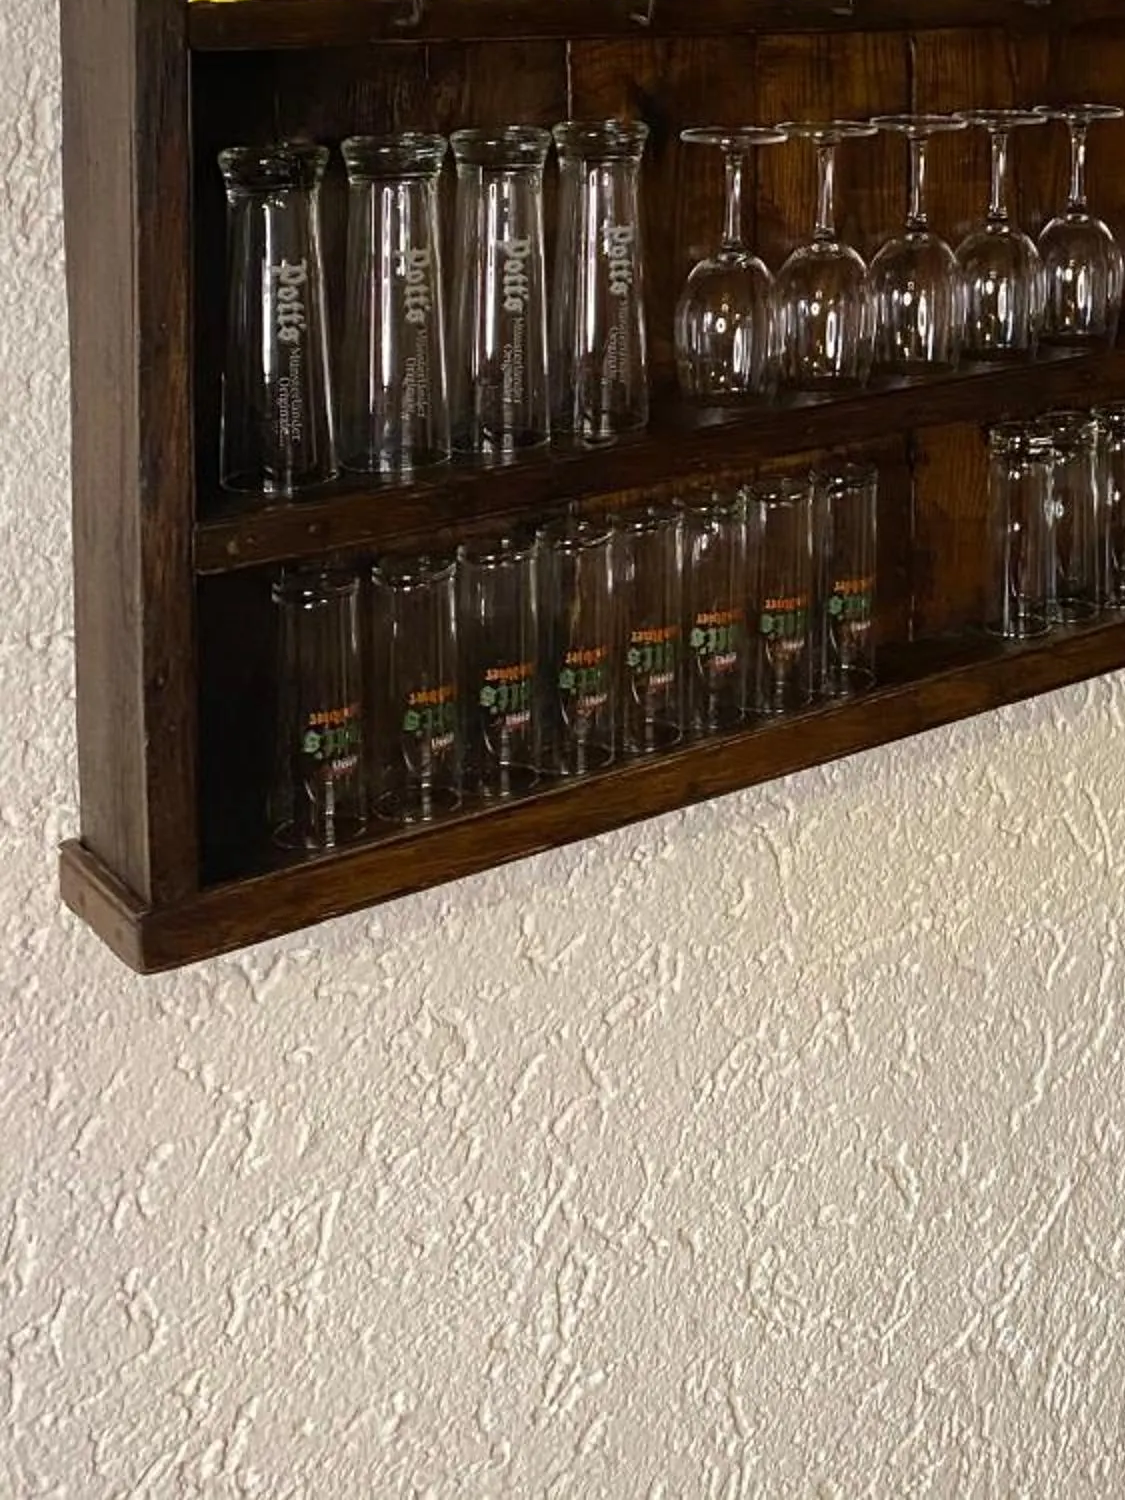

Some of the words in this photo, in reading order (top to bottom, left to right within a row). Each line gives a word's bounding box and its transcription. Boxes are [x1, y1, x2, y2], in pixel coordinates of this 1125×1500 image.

[395, 246, 431, 324] Pott's
[497, 236, 531, 313] Pott's
[600, 223, 632, 296] Pott's
[271, 258, 308, 344] Pott's
